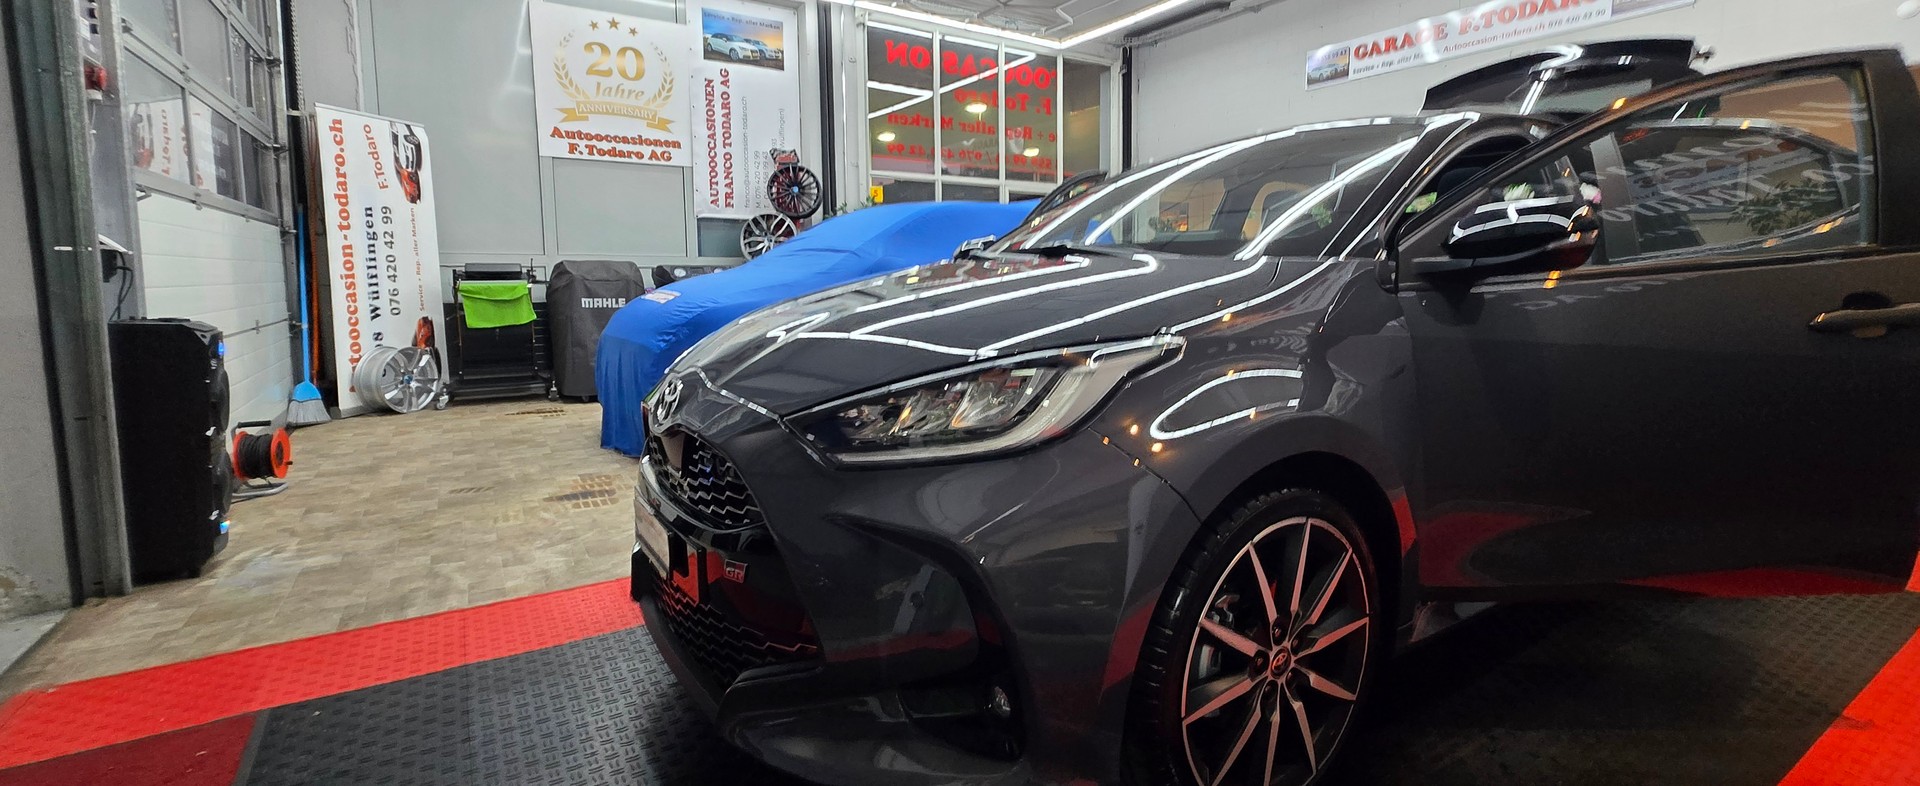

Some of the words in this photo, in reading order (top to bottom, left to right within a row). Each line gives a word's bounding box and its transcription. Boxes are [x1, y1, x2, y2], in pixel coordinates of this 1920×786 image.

[584, 41, 646, 82] 20
[719, 67, 730, 88] AG
[595, 81, 645, 101] Jahre
[577, 103, 656, 120] ANNIVERSARY
[720, 92, 733, 149] TODARO
[550, 126, 682, 149] Autooccasionen
[704, 77, 719, 208] AUTOOCCASIONEN
[361, 124, 389, 190] F.Todaro
[567, 142, 584, 156] F.
[585, 143, 645, 160] Todaro
[648, 149, 673, 162] AG
[723, 151, 735, 209] FRANCO
[380, 205, 393, 224] 99
[409, 207, 418, 238] Marken
[383, 230, 396, 249] 42
[412, 239, 420, 256] aller
[361, 206, 383, 321] Wülflingen
[385, 255, 399, 284] 420
[414, 259, 423, 276] Rep.
[388, 287, 402, 316] 076
[417, 284, 425, 311] Service
[581, 297, 627, 309] MAHLE
[725, 566, 745, 581] GR
